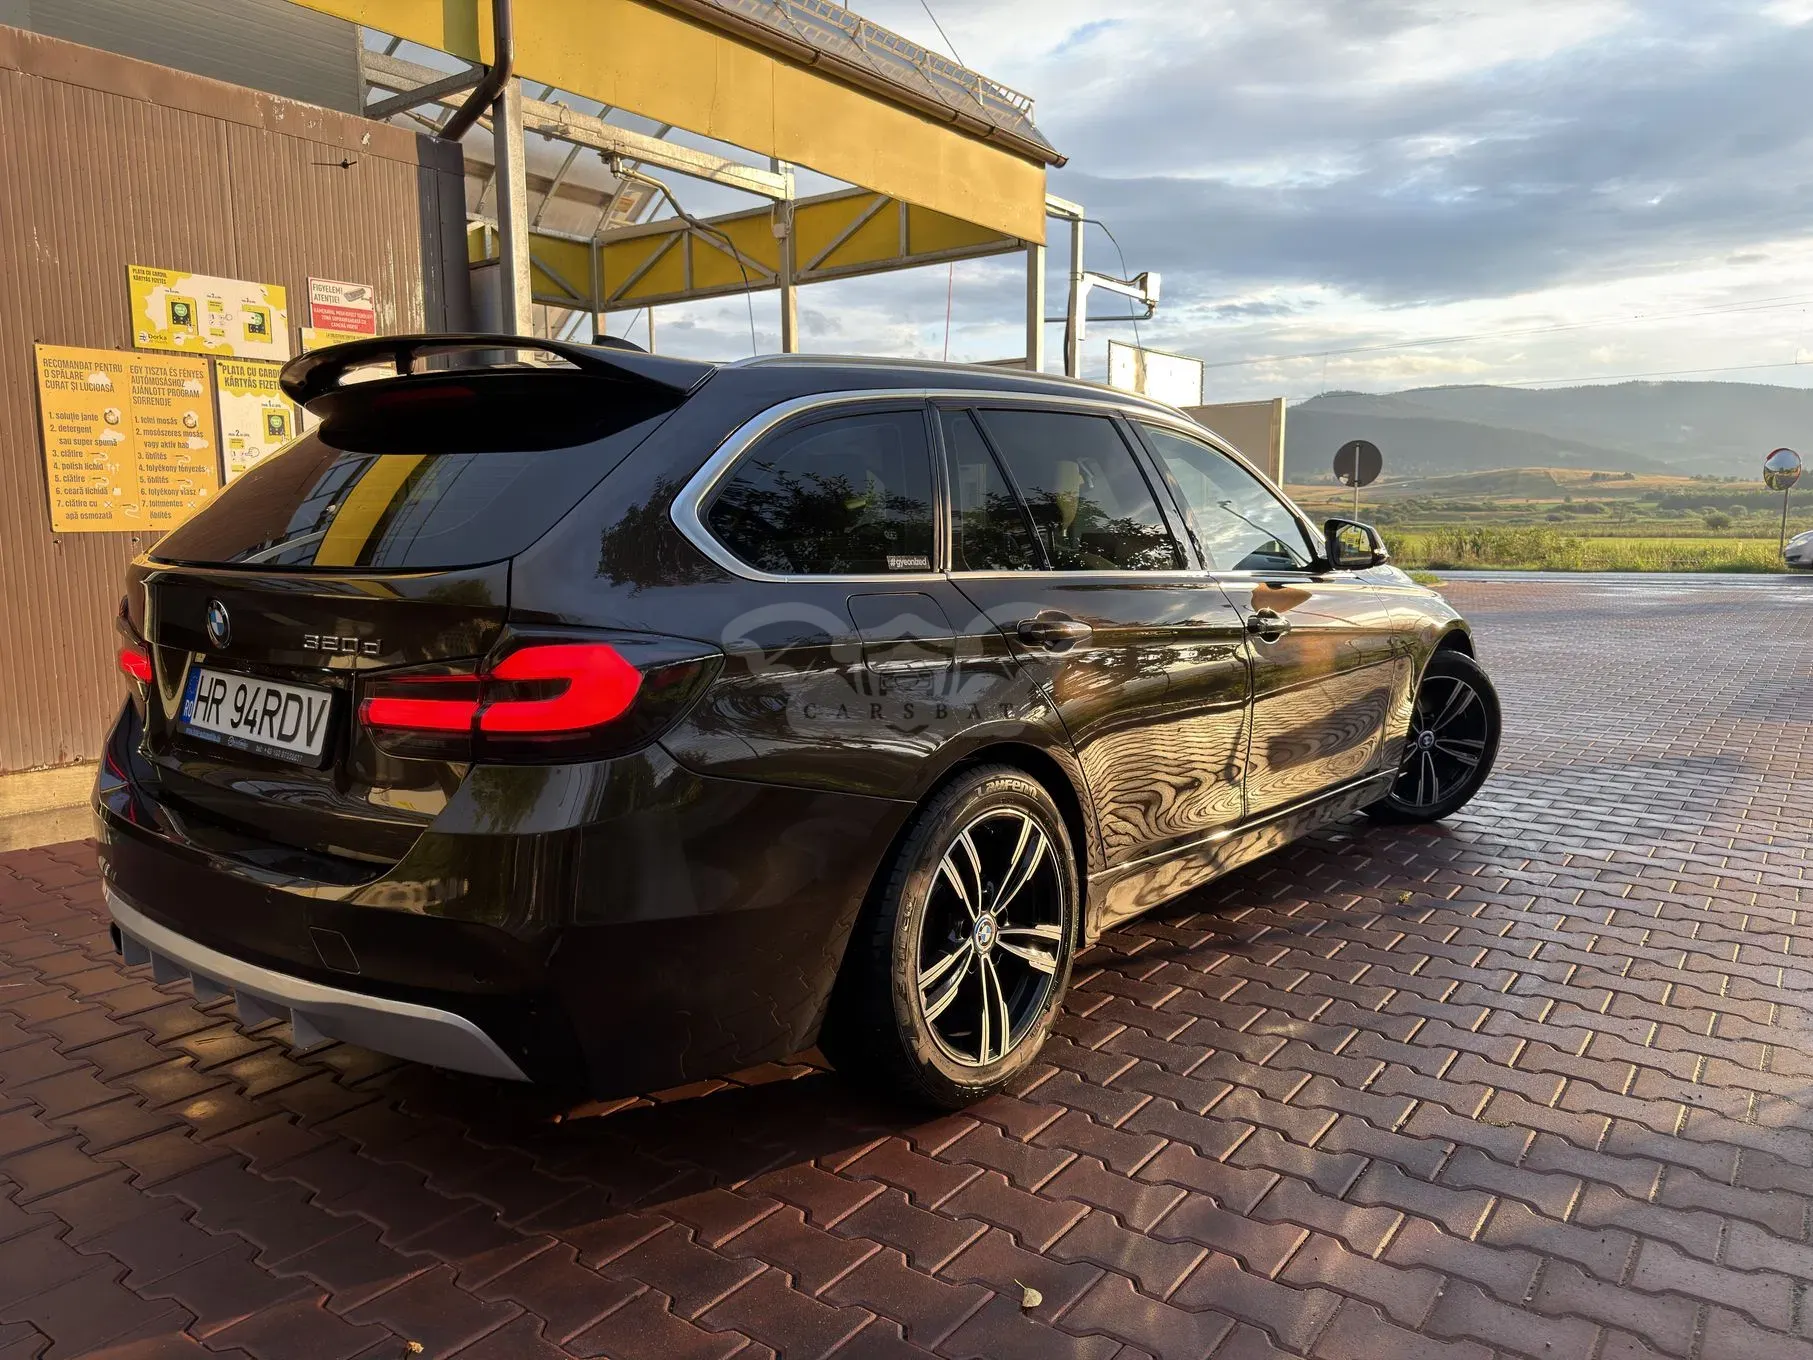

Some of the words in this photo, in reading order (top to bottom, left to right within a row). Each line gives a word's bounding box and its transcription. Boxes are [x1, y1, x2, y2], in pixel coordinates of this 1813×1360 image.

[312, 283, 343, 295] FIGYELEM!
[43, 358, 92, 370] RECOMANDAT
[94, 362, 123, 373] PENTRU
[222, 365, 245, 376] PLATA
[247, 366, 256, 377] CU
[51, 368, 84, 380] SPĂLARE
[130, 365, 143, 375] EGY
[144, 366, 168, 376] TISZTA
[169, 366, 178, 377] ÉS
[179, 368, 204, 379] FÉNYES
[45, 379, 69, 390] CURAT
[224, 375, 257, 389] KÁRTYÁS
[132, 385, 166, 396] AJÁNLOTT
[167, 388, 200, 398] PROGRAM
[58, 424, 92, 434] detergent
[73, 438, 93, 446] super
[94, 438, 118, 447] spumă
[61, 462, 83, 470] polish
[193, 675, 227, 725] HR
[184, 699, 194, 718] RO
